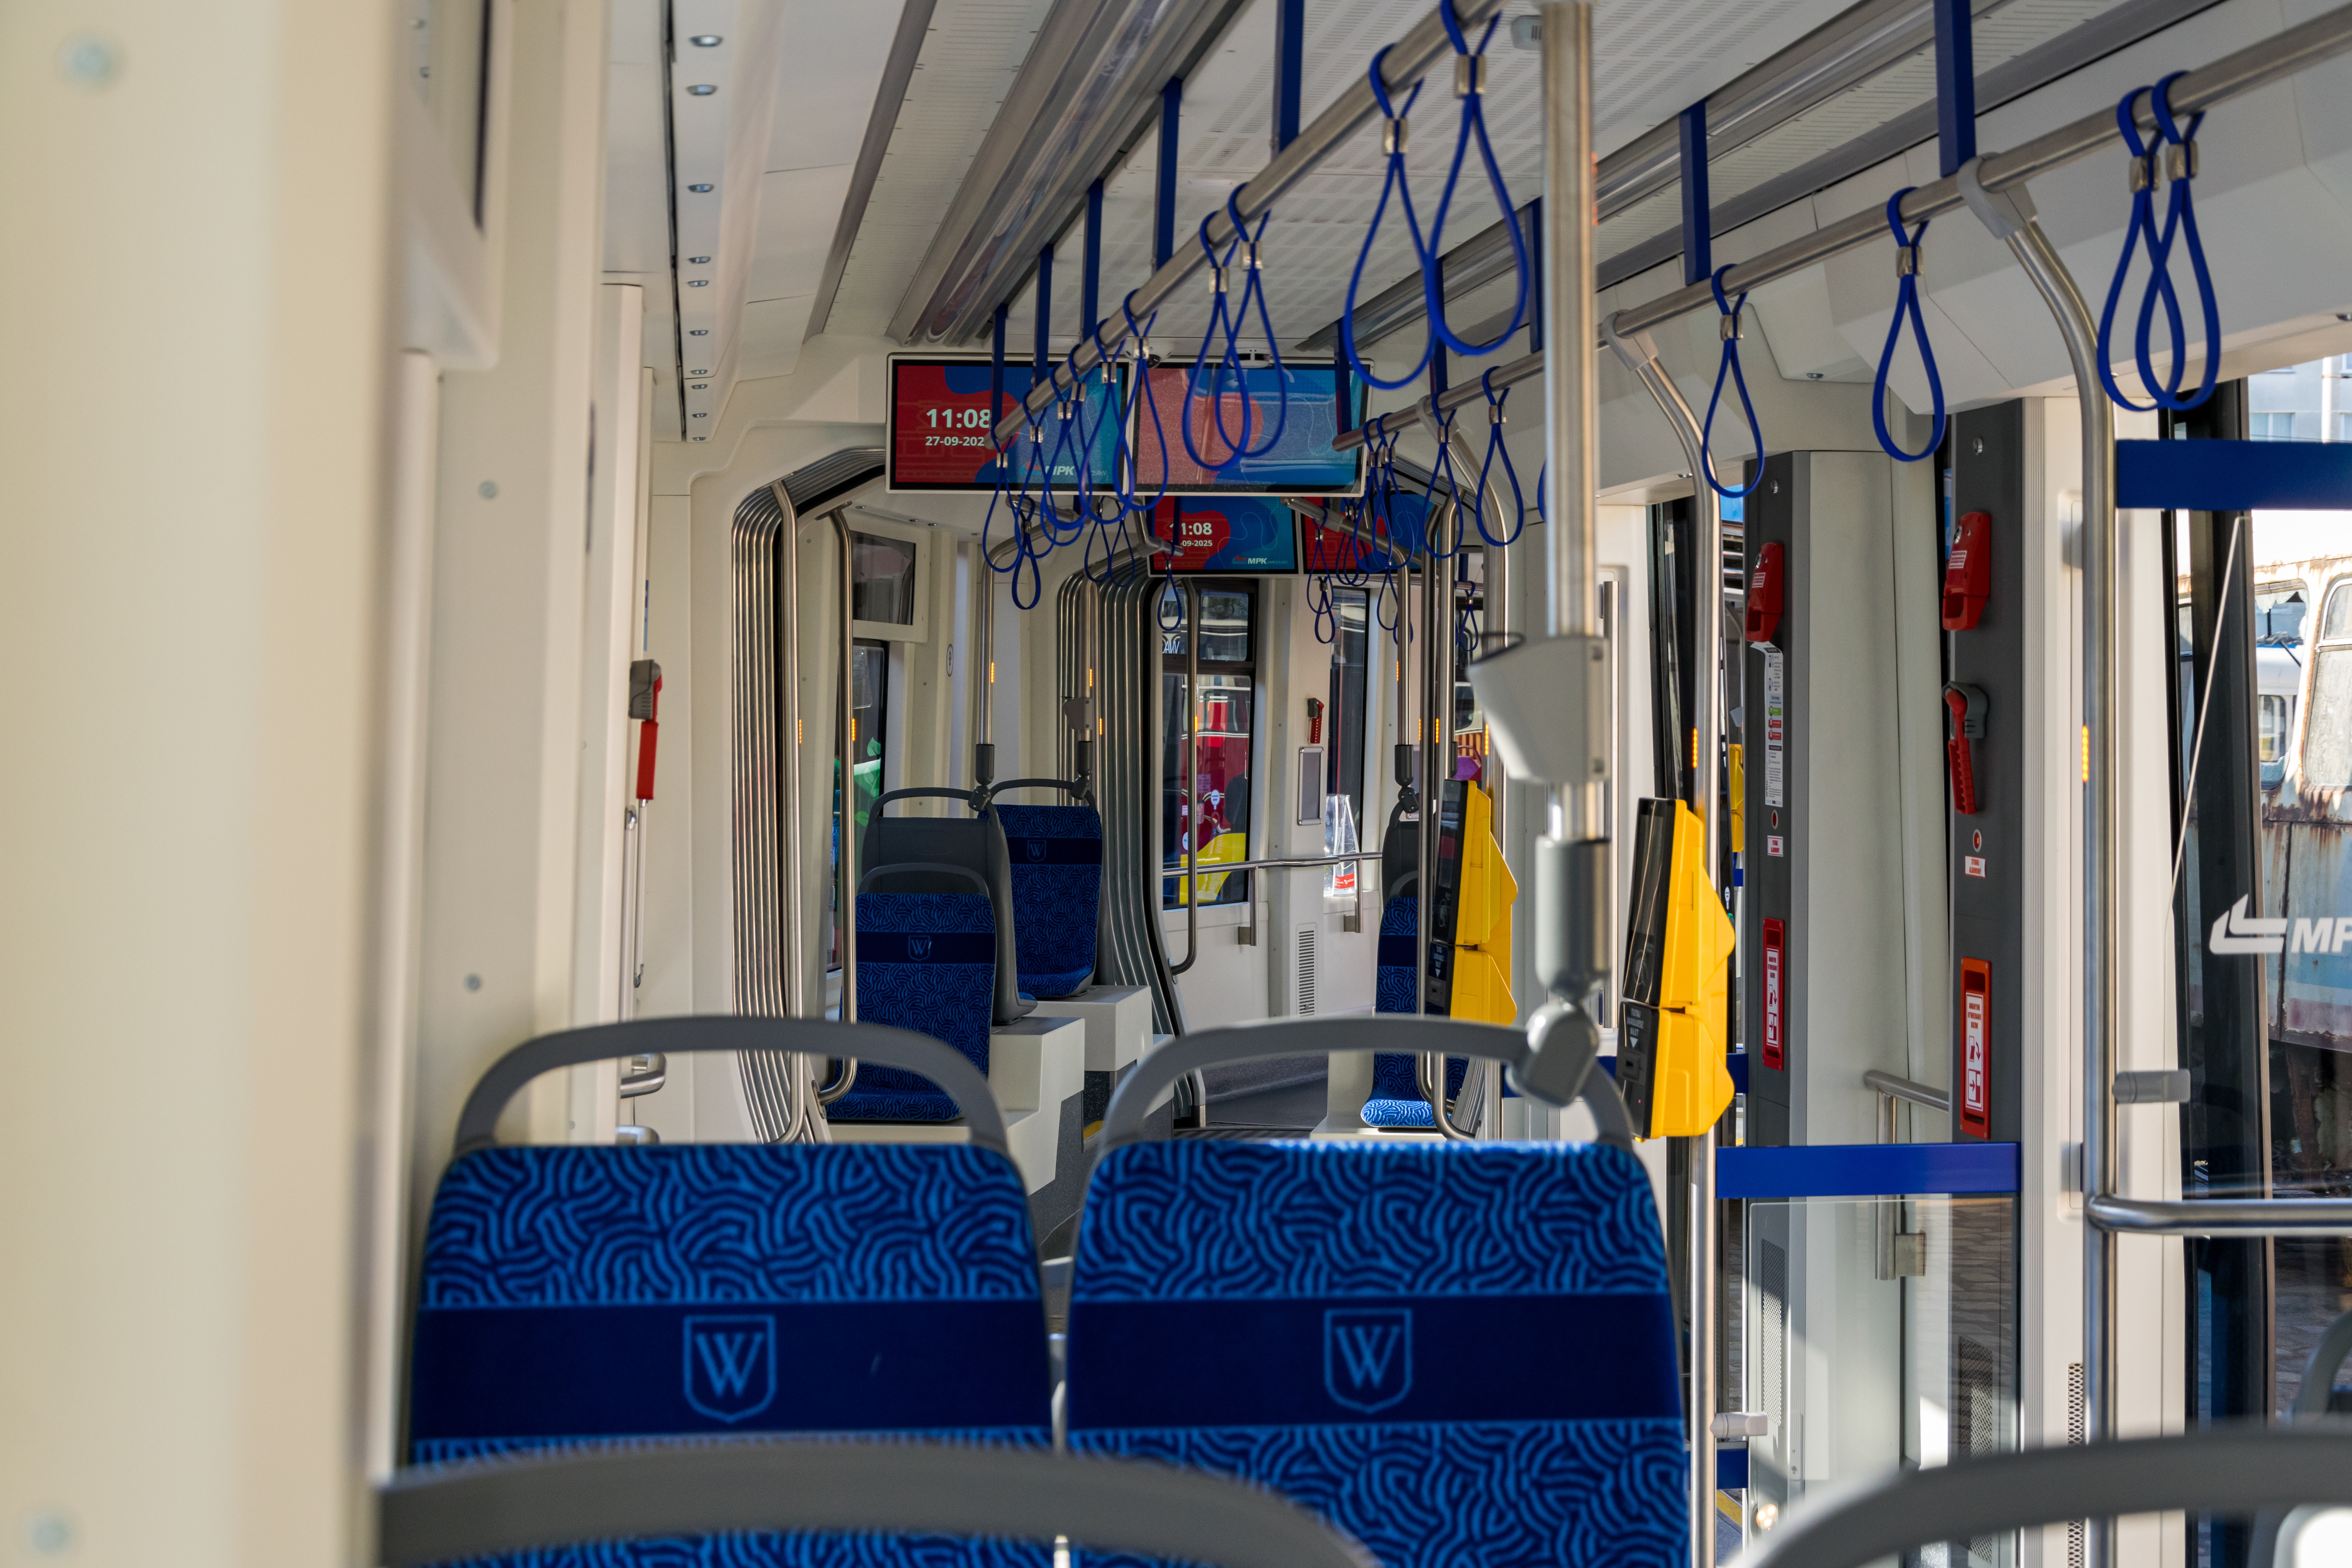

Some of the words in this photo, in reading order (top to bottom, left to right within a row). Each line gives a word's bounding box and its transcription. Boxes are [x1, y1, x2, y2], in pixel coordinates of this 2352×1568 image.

[926, 408, 990, 428] 11:08
[925, 436, 984, 446] 27-09-202
[1170, 522, 1212, 535] 1:08
[1029, 843, 1044, 857] W
[911, 939, 928, 955] W
[1335, 1325, 1401, 1389] W
[694, 1332, 765, 1399] W
